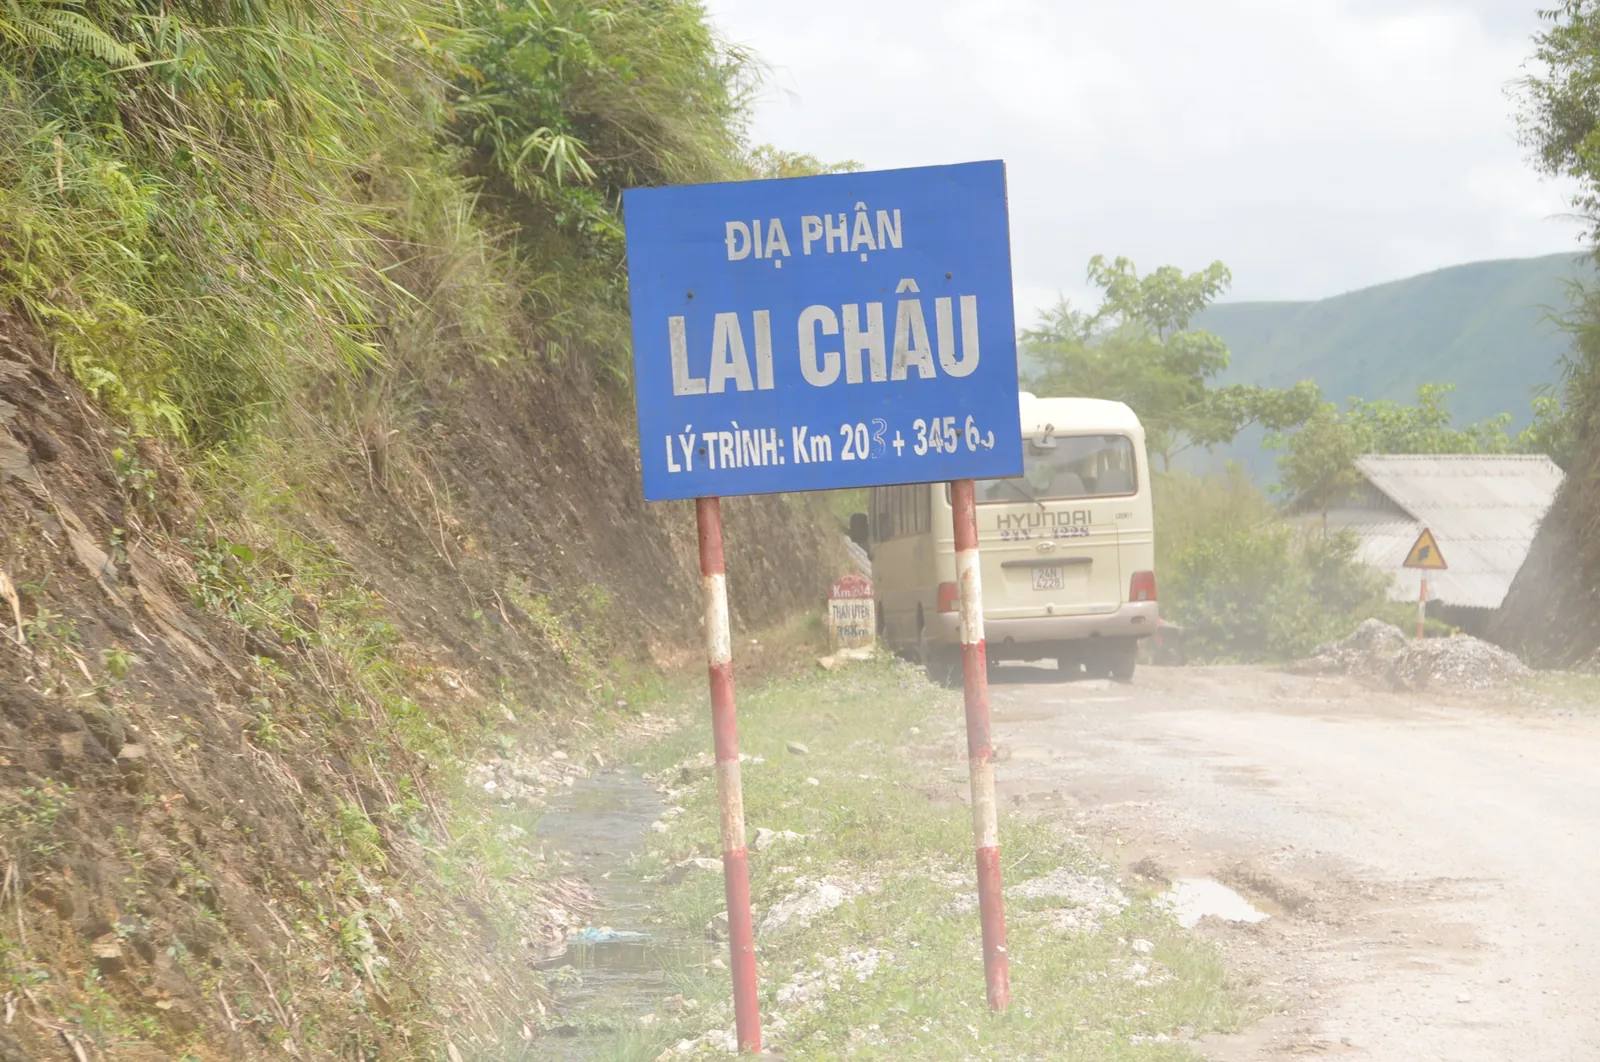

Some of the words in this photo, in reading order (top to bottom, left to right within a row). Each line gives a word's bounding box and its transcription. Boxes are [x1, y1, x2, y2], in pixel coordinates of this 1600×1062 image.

[801, 201, 903, 262] PHẬN
[668, 309, 775, 396] LAI
[797, 278, 980, 387] CHÂU
[665, 424, 695, 473] LÝ
[702, 421, 785, 470] TRÌNH:
[792, 425, 833, 464] Km
[997, 510, 1092, 529] HYUNDAI
[833, 584, 851, 599] Km
[1036, 578, 1061, 589] 4228
